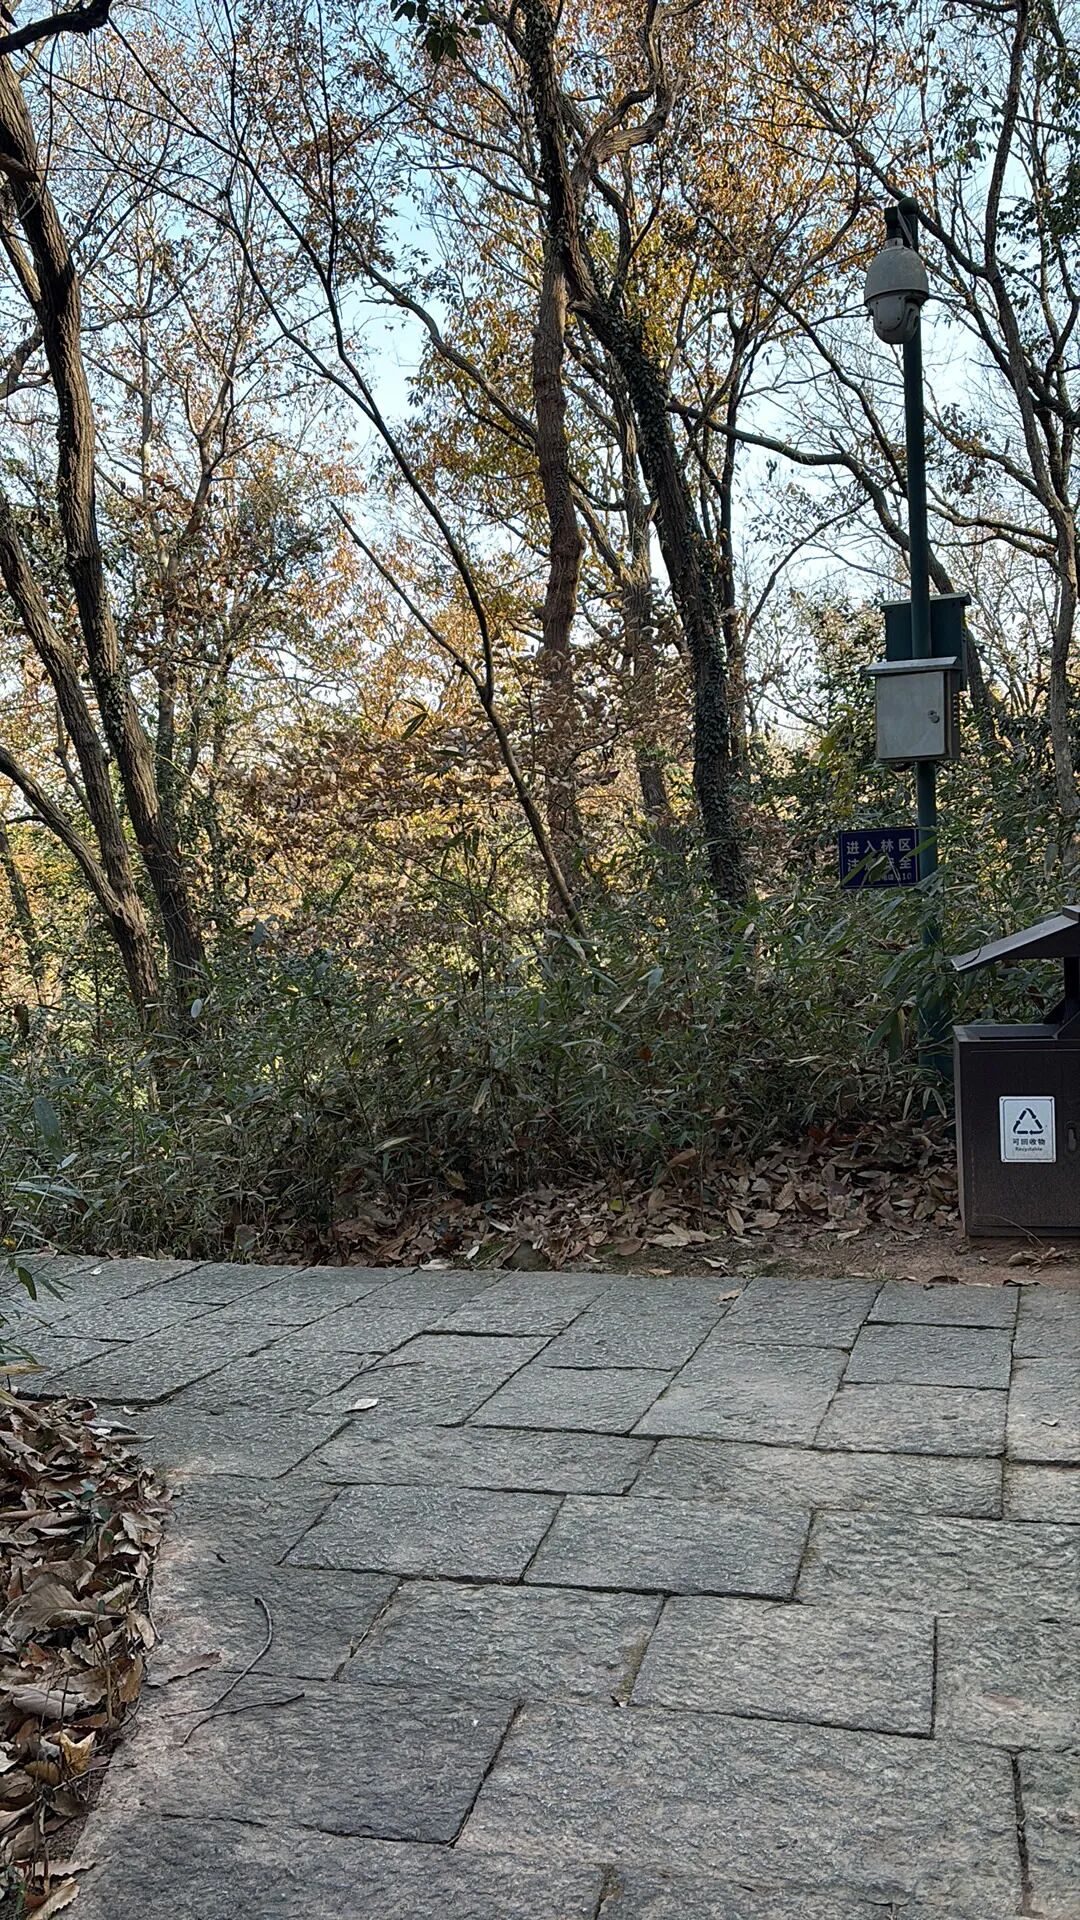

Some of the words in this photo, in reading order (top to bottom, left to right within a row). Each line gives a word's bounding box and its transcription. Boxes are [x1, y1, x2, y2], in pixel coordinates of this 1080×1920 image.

[847, 839, 911, 855] 进入林区
[1013, 1138, 1046, 1146] 可回收物
